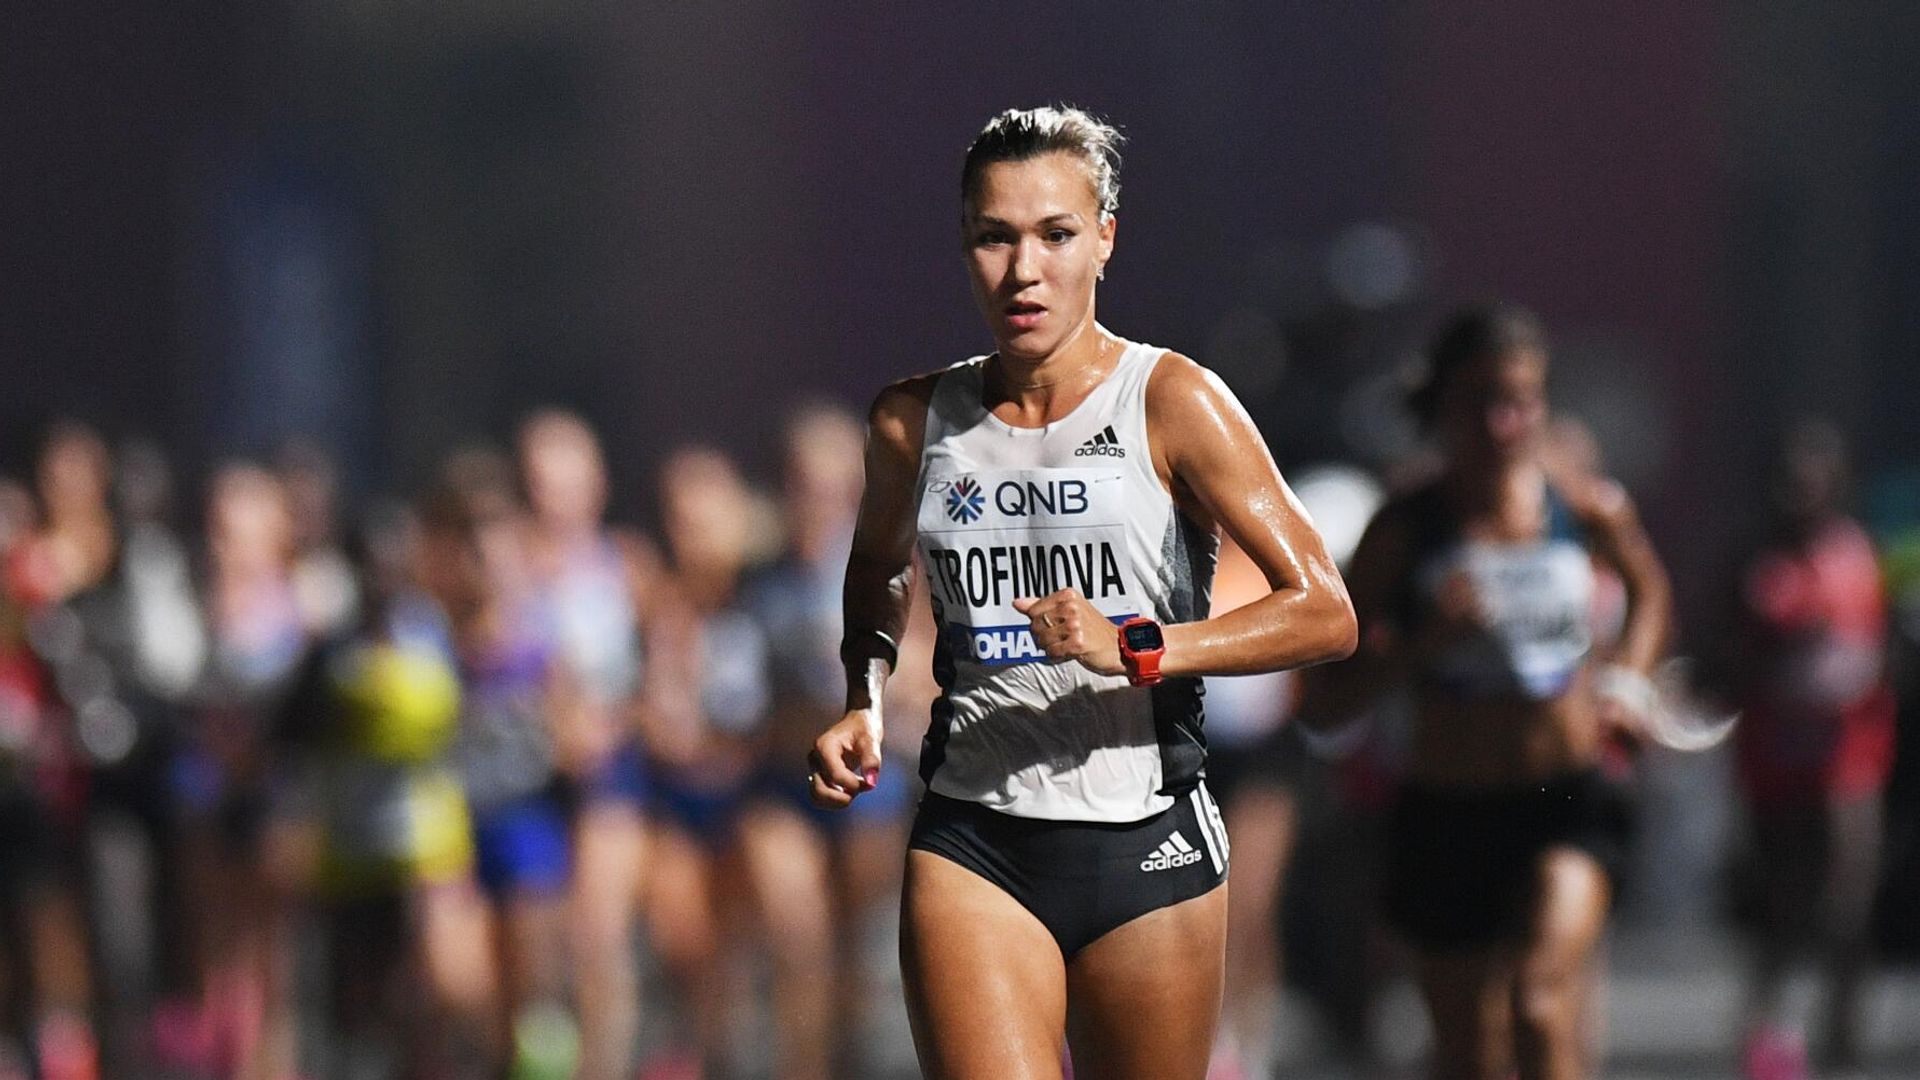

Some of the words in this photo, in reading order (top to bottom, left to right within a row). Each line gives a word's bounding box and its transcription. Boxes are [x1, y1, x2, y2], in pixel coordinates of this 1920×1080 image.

[1074, 443, 1126, 459] adidas
[995, 480, 1089, 517] QNB
[929, 541, 1126, 608] TROFIMOVA
[1140, 849, 1202, 872] adidas
